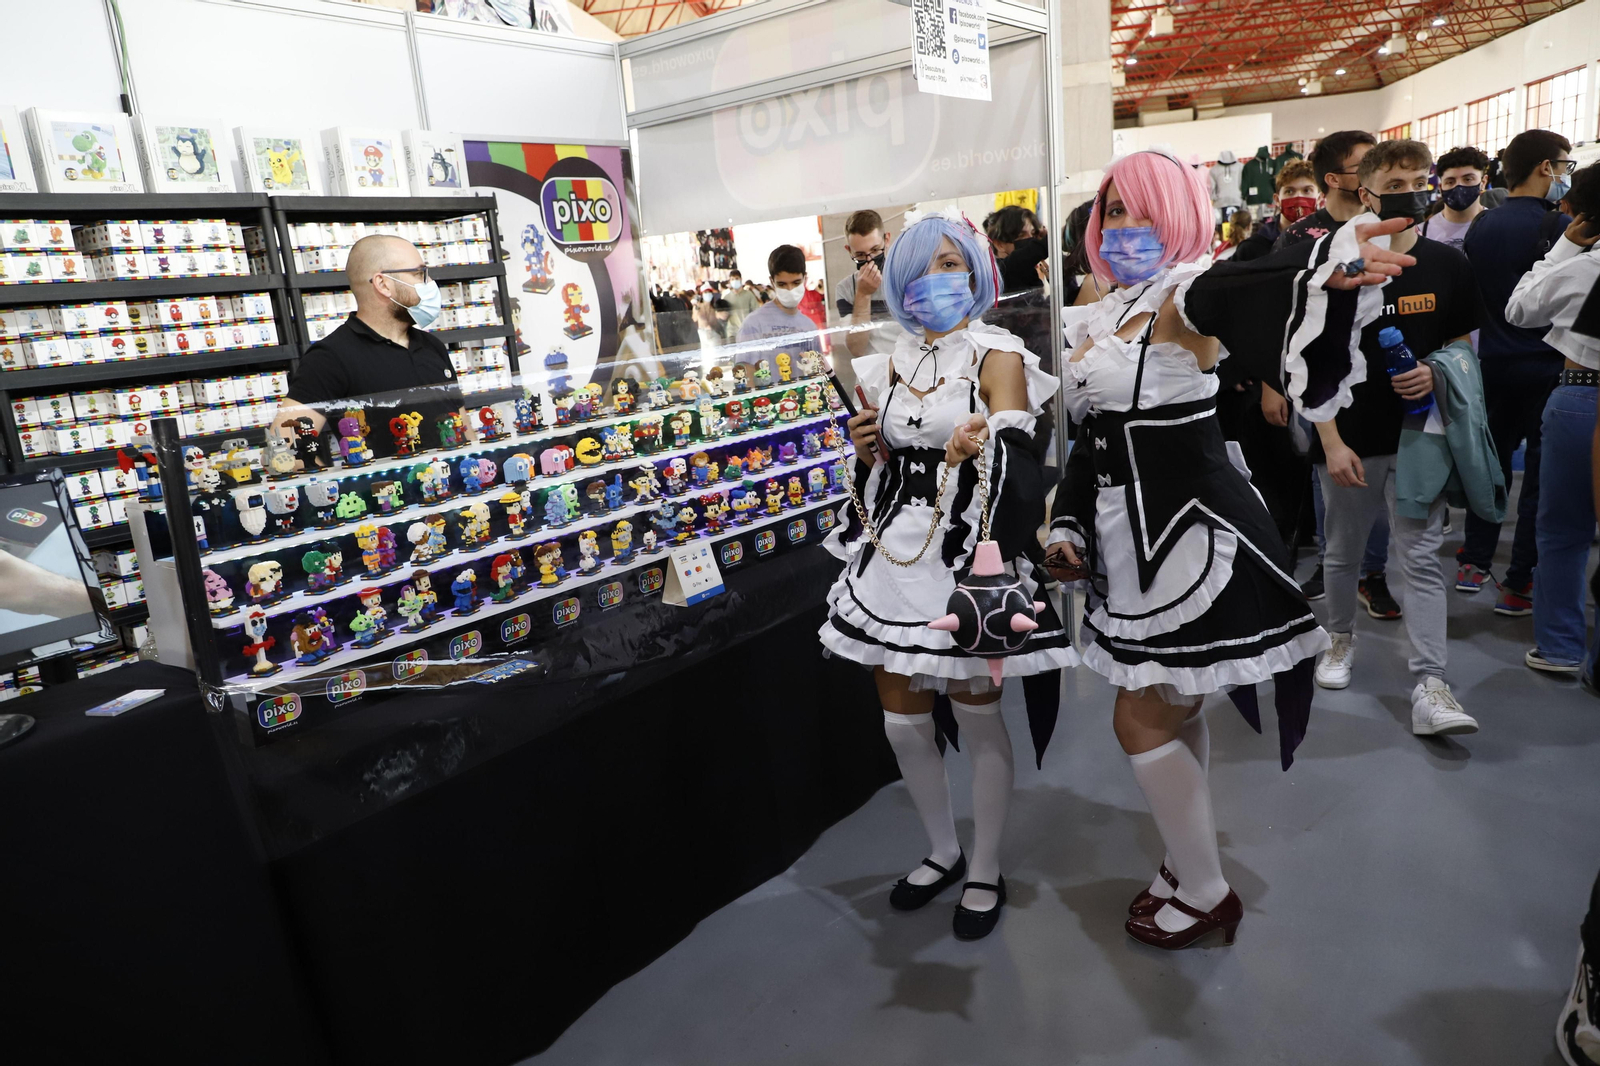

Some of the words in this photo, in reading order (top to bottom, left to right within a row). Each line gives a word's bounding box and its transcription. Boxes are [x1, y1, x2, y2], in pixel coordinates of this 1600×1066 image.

[552, 192, 612, 230] pixo
[564, 244, 612, 255] pixoworld.es
[1380, 303, 1396, 317] rn
[1401, 297, 1434, 312] hub
[12, 512, 40, 523] pixo
[819, 513, 833, 526] pixo
[789, 524, 805, 537] pixo
[757, 535, 773, 549] pixo
[723, 547, 740, 560] pixo
[641, 574, 660, 588] pixo
[601, 589, 620, 603] pixo
[556, 604, 577, 620] pixo
[504, 621, 527, 638] pixo
[453, 638, 478, 656] pixo
[397, 657, 424, 676] pixo
[331, 678, 361, 698] pixo
[263, 702, 296, 723] pixo
